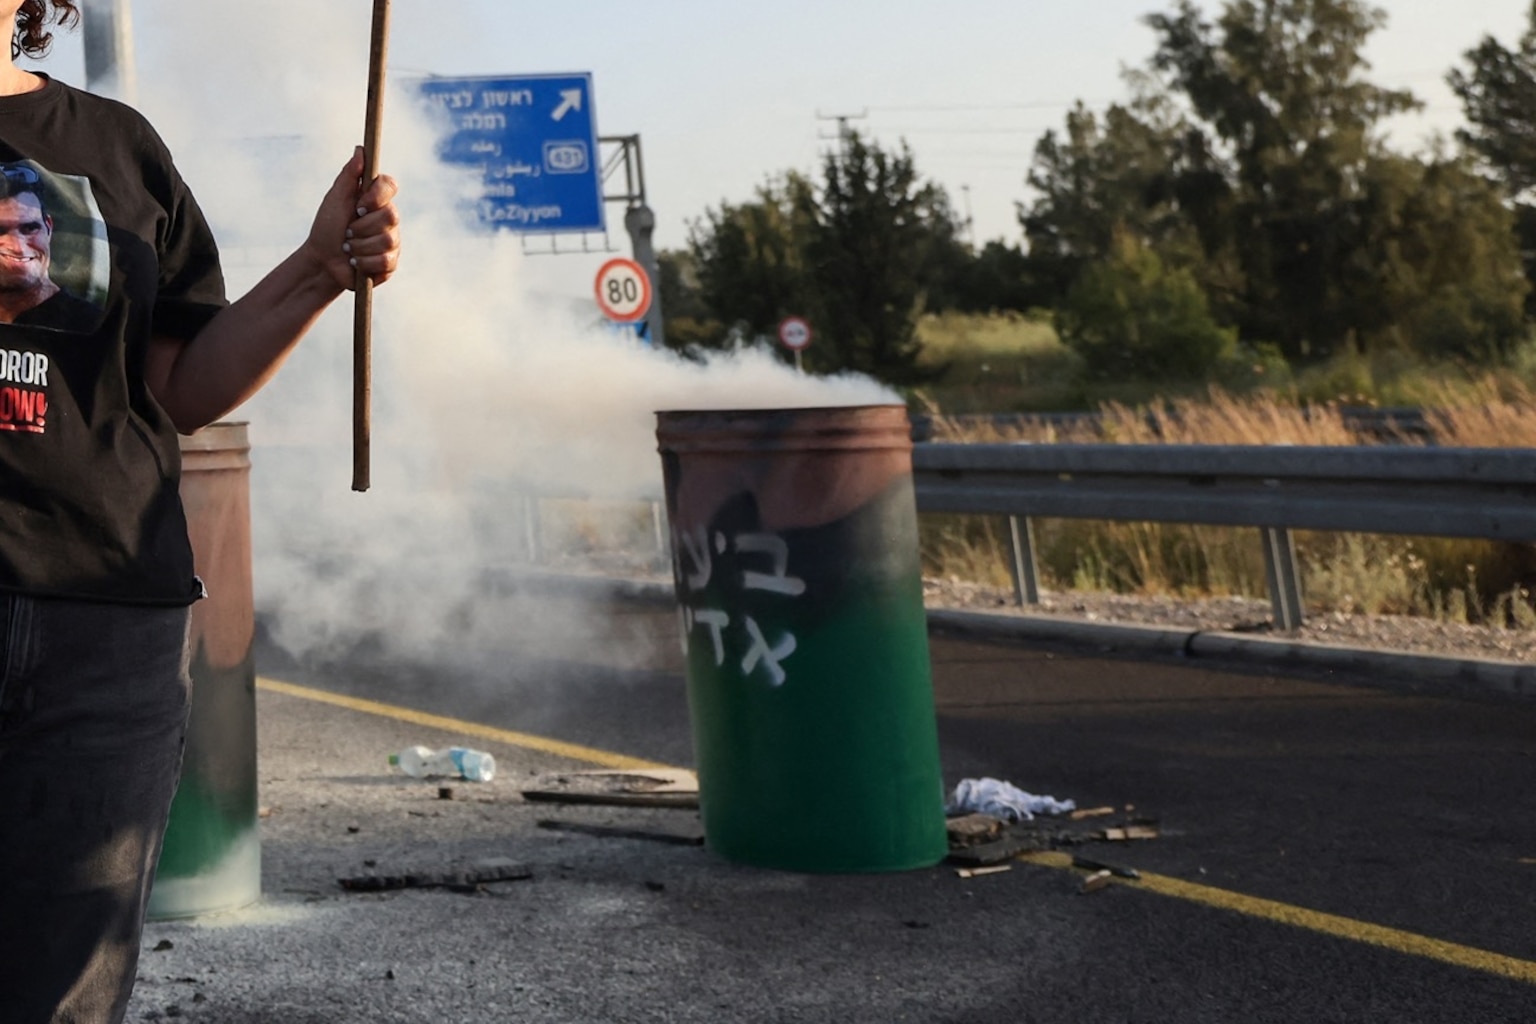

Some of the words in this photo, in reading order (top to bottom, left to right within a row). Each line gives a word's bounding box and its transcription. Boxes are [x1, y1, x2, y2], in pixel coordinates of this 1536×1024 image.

[482, 89, 533, 109] ראשון
[462, 112, 506, 129] רמלה
[608, 277, 638, 304] 80
